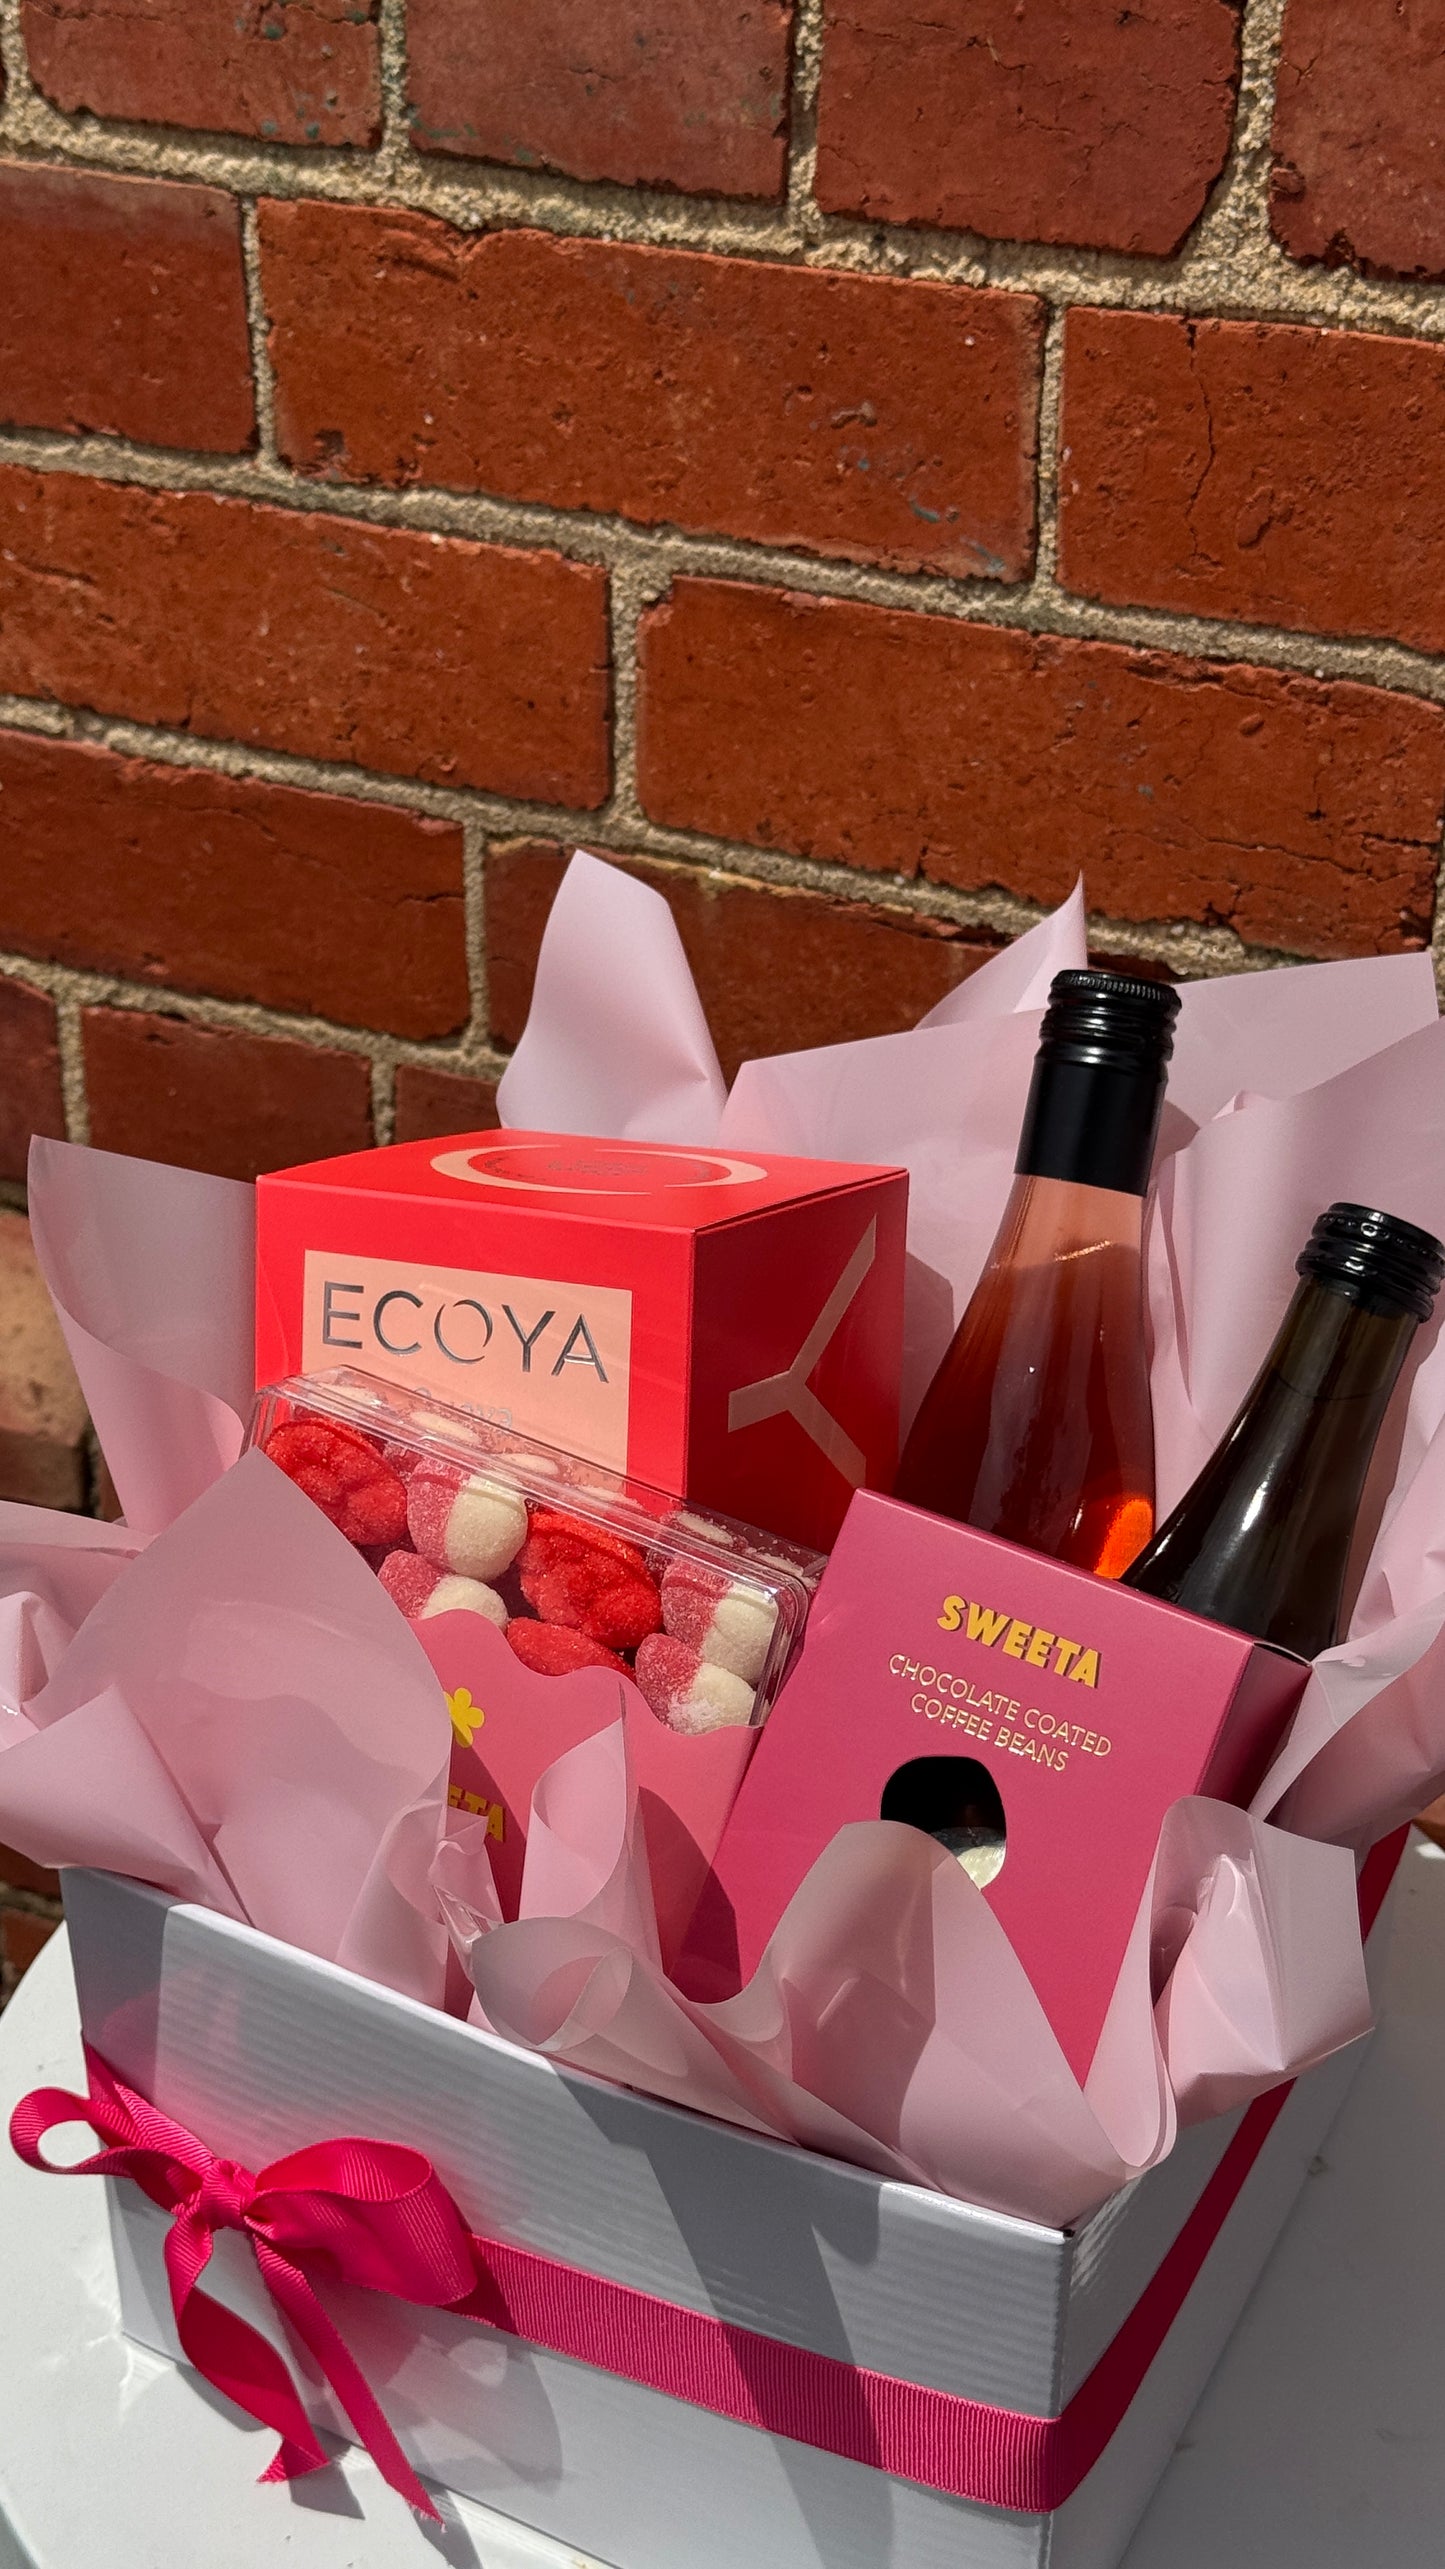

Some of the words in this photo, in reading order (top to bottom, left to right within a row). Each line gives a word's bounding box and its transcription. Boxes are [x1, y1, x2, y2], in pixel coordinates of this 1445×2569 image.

[322, 1280, 610, 1384] ECOYA
[936, 1594, 1101, 1688] SWEETA
[889, 1654, 1021, 1721] CHOCOLATE
[1023, 1708, 1112, 1766] COATED
[911, 1693, 993, 1741] COFFEE
[994, 1726, 1069, 1772] BEANS
